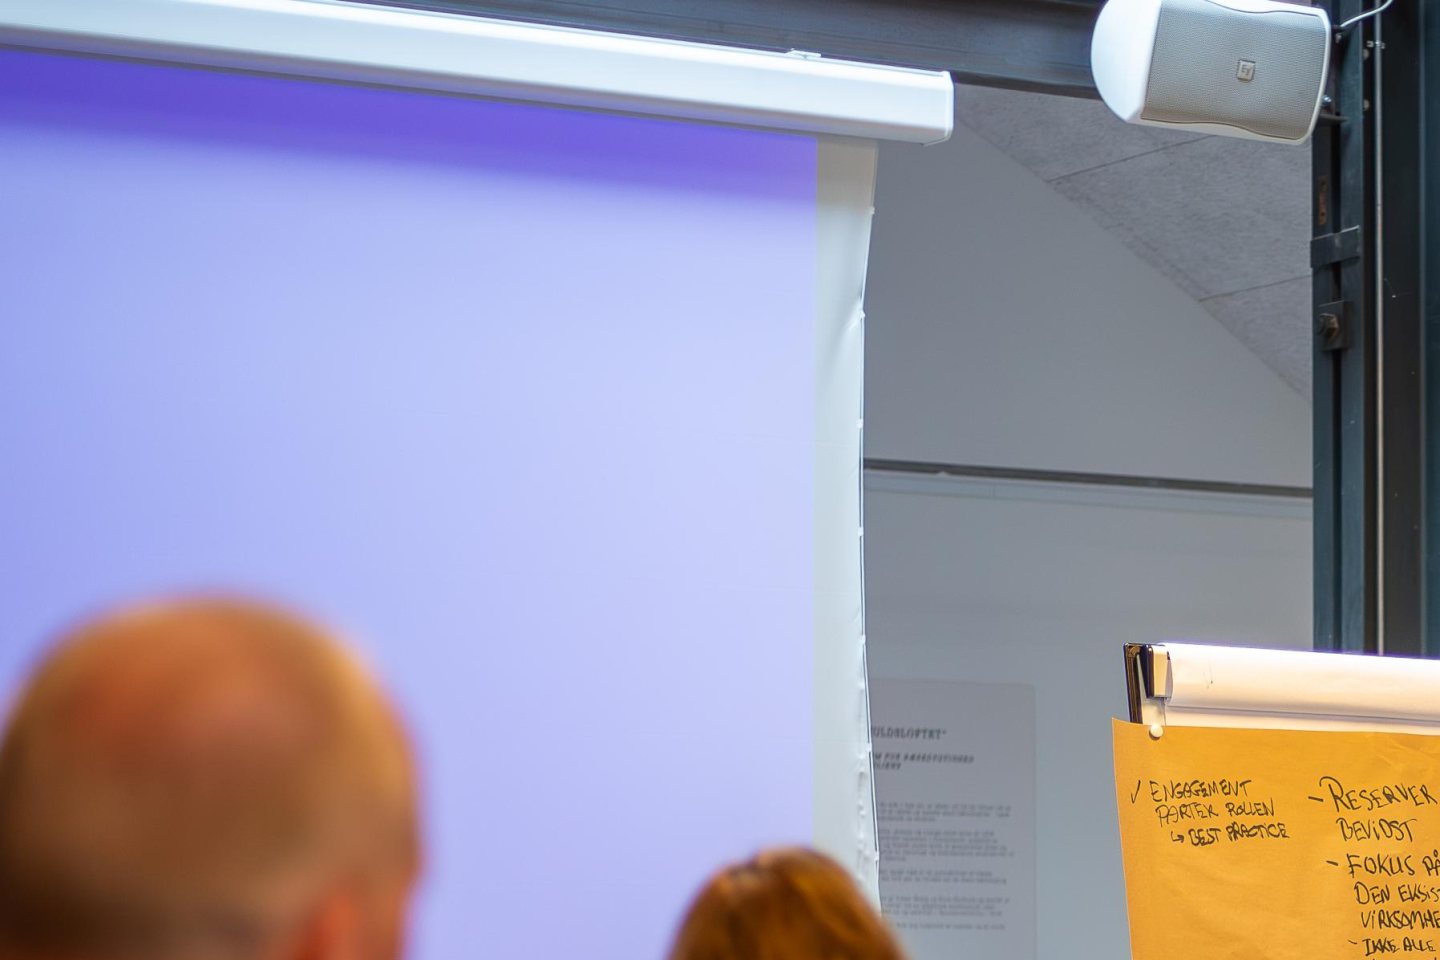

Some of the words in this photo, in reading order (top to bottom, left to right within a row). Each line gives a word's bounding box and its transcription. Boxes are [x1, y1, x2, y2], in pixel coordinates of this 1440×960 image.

[1149, 779, 1252, 802] ENGAGEMENT
[1319, 776, 1438, 813] RESERVER
[1346, 853, 1416, 879] FOKUS
[1354, 881, 1390, 904] DEN
[1402, 936, 1436, 952] ALLE
